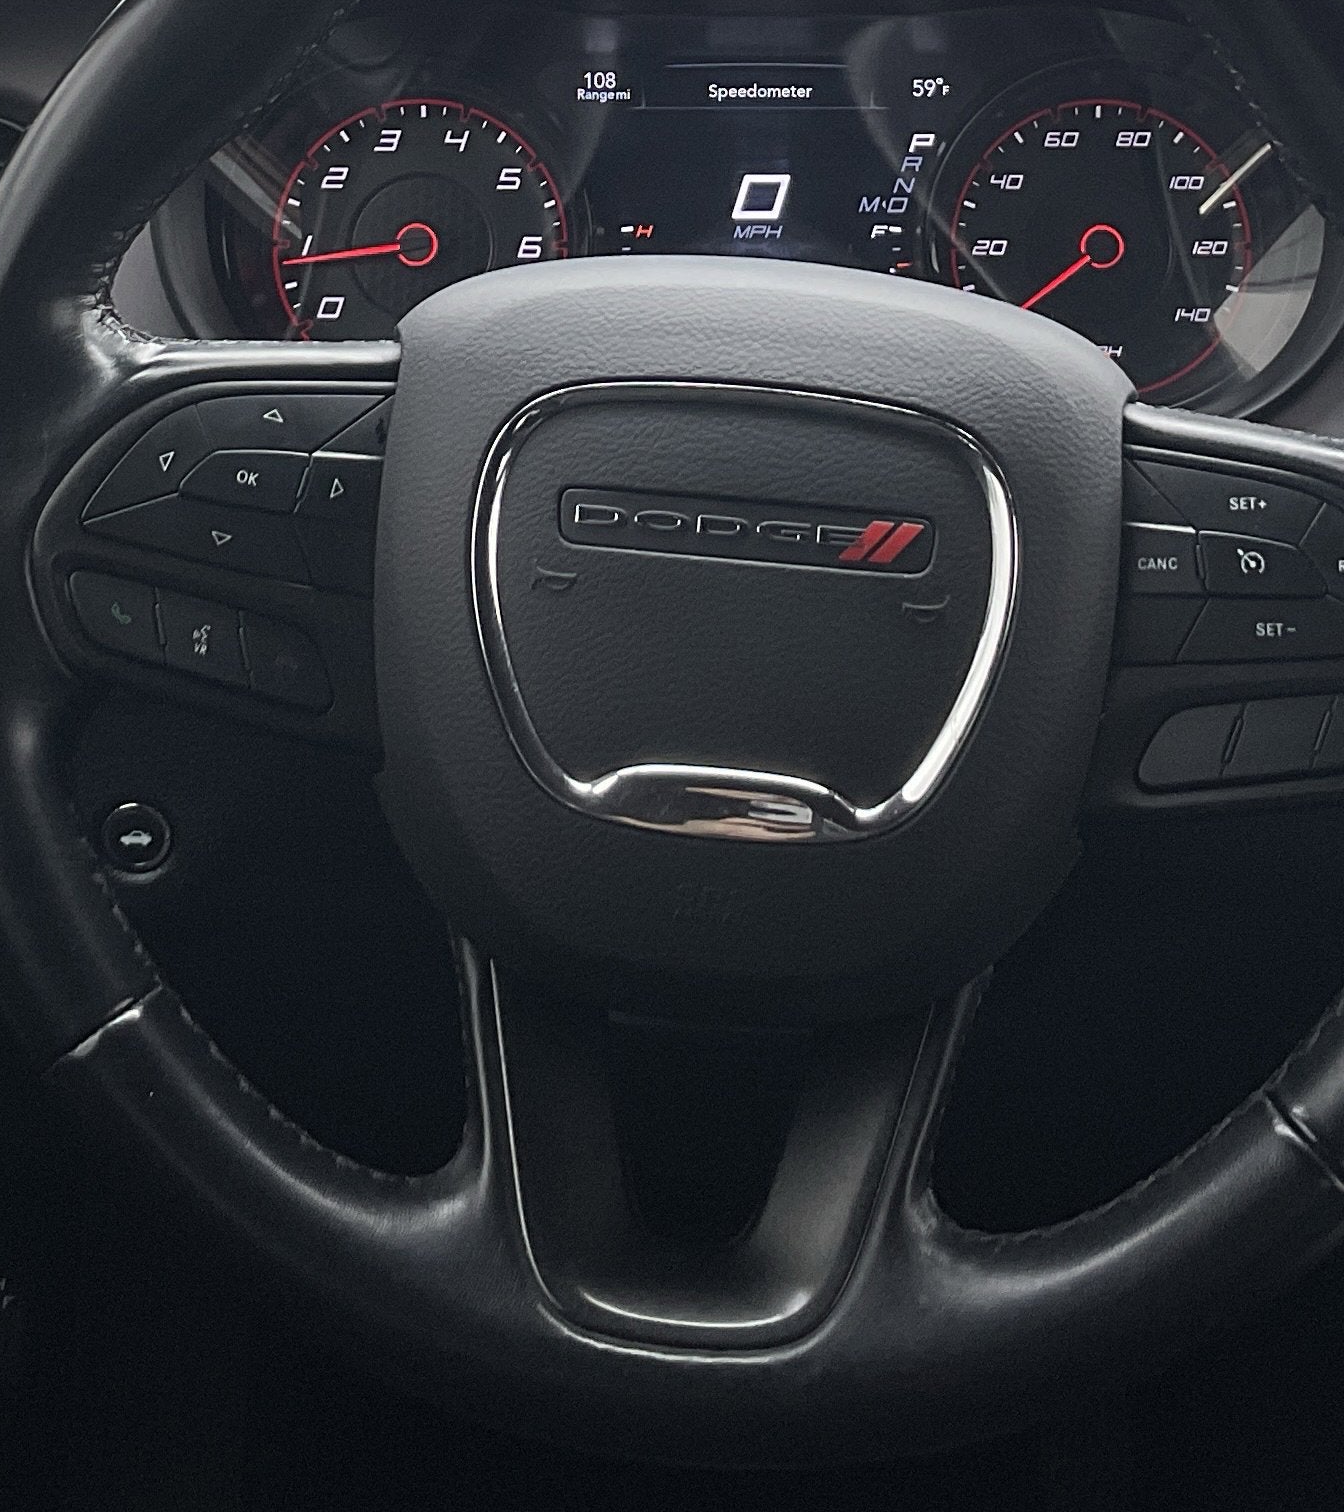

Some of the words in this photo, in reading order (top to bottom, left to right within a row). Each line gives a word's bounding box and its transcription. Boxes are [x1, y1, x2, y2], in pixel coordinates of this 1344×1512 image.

[583, 72, 617, 88] 108
[708, 84, 813, 101] Speedometer
[374, 129, 402, 152] 3
[444, 129, 470, 152] 4
[909, 133, 935, 152] P
[1043, 131, 1080, 148] 60
[1115, 131, 1152, 148] 80
[900, 156, 923, 173] R
[320, 166, 349, 189] 2
[496, 167, 522, 190] 5
[893, 178, 916, 194] N
[989, 173, 1024, 190] 40
[1168, 175, 1205, 191] 100
[731, 173, 791, 221] 0
[634, 224, 654, 239] H
[733, 224, 783, 239] MPH
[870, 224, 888, 239] F
[302, 234, 313, 256] 1
[517, 236, 543, 259] 6
[971, 239, 1008, 257] 20
[1192, 240, 1229, 256] 120
[316, 296, 345, 319] 0
[1174, 307, 1212, 323] 140
[237, 469, 259, 487] OK
[575, 503, 868, 546] DODGE
[1138, 557, 1178, 571] CANC
[193, 642, 207, 656] VR
